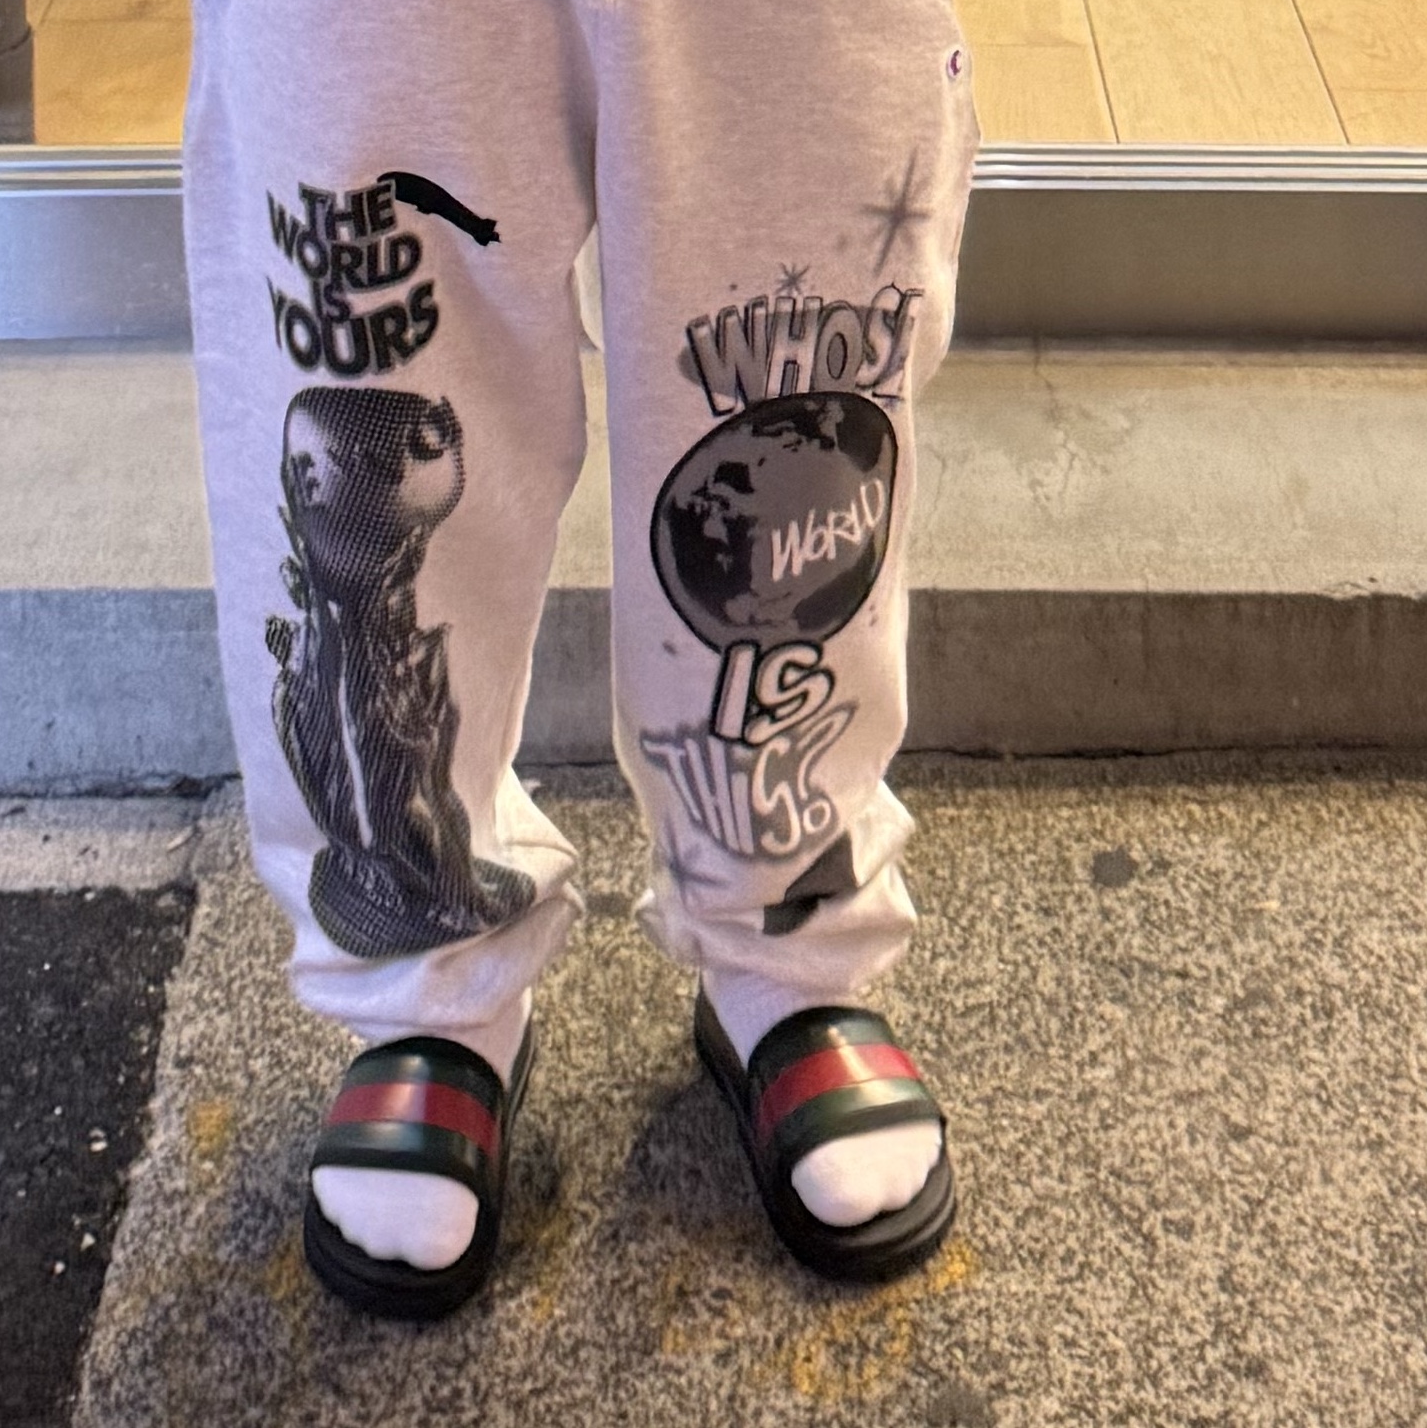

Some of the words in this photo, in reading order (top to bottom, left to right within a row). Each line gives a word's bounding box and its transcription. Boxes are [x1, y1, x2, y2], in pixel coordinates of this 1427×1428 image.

[267, 191, 422, 290] WORLD
[298, 181, 397, 241] THE
[267, 276, 439, 377] YOURS
[711, 640, 835, 747] IS
